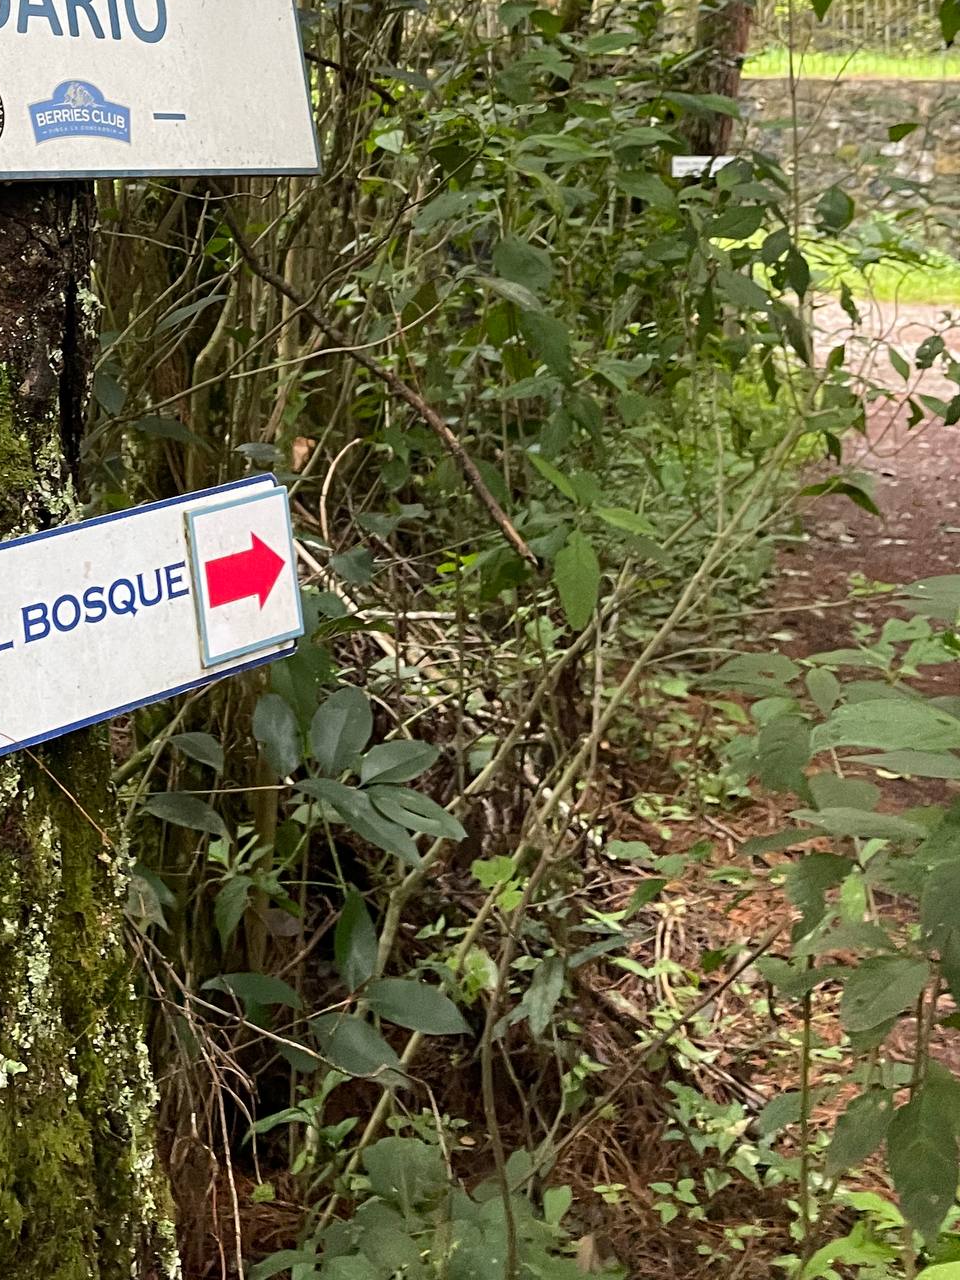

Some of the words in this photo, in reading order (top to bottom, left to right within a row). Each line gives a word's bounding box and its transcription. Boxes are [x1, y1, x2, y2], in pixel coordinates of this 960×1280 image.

[35, 108, 90, 127] BERRIES
[91, 109, 126, 129] CLUB
[21, 561, 190, 644] BOSQUE
